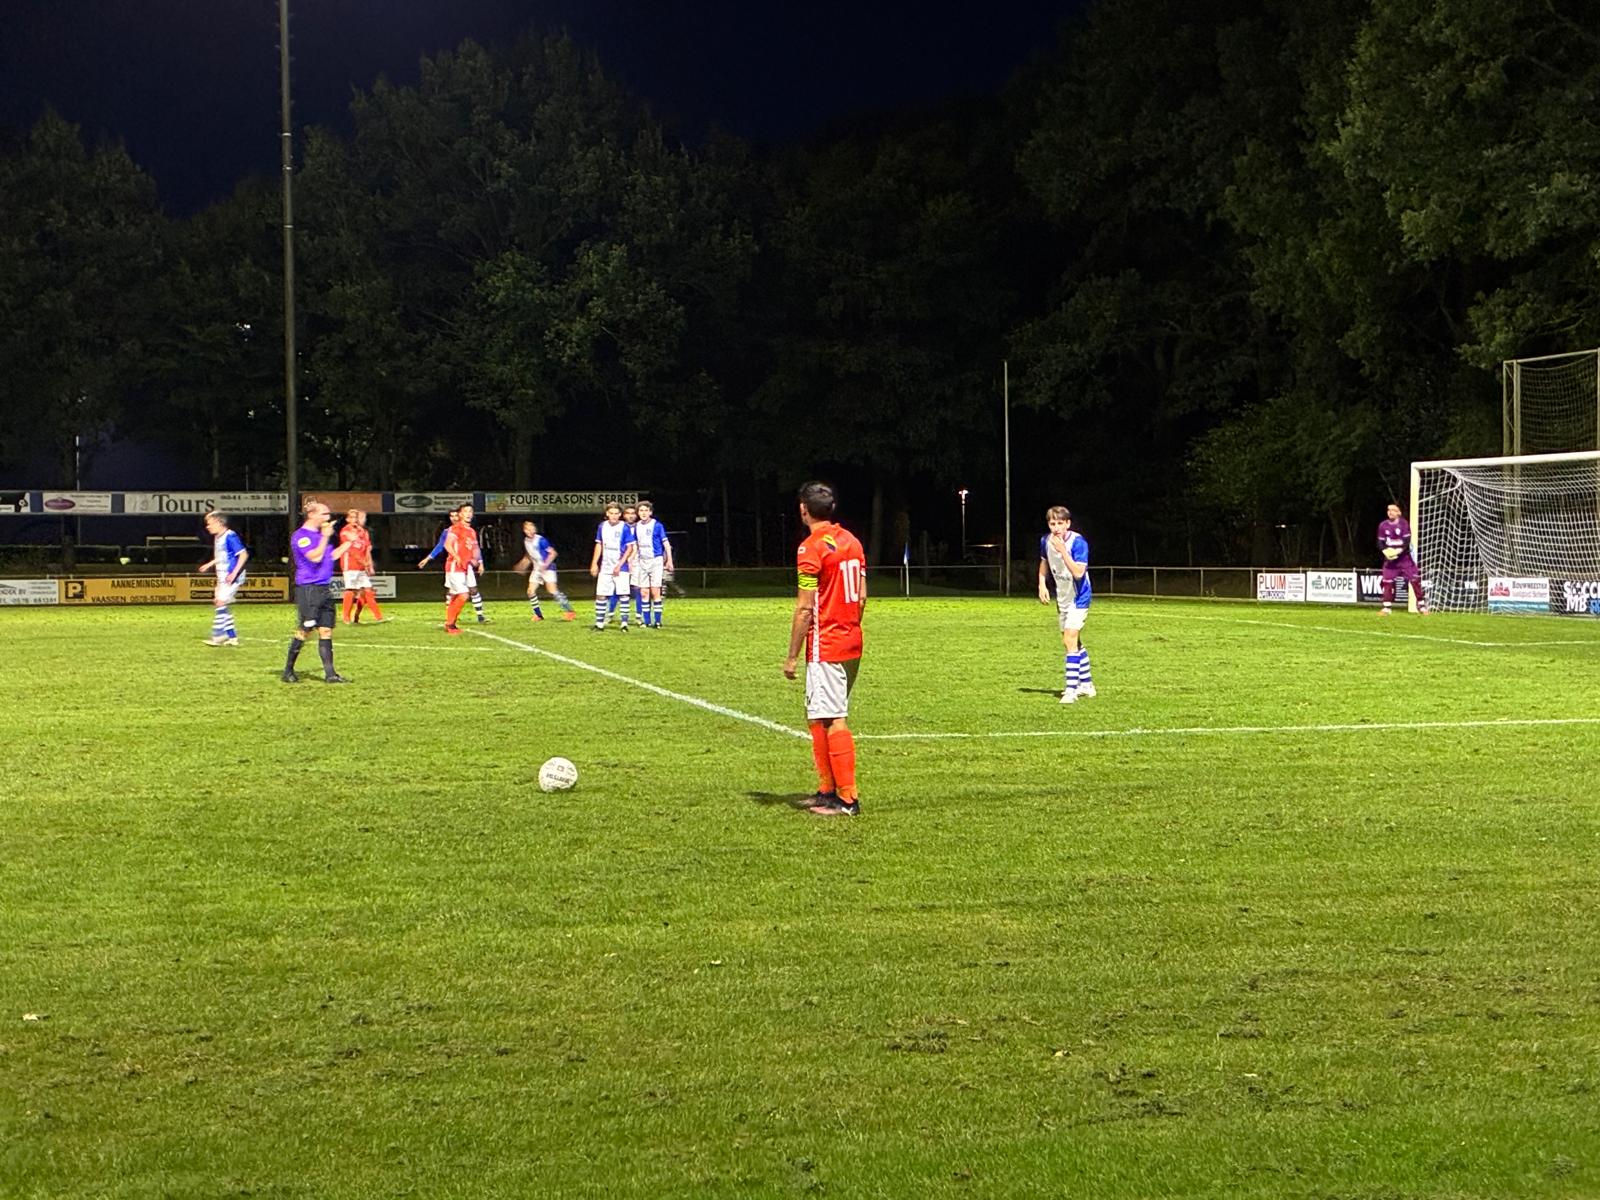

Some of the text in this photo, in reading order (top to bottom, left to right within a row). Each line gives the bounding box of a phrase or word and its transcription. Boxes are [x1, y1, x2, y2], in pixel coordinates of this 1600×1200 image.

[152, 494, 215, 513] Tours
[509, 494, 539, 504] FOUR
[598, 494, 636, 504] SERRES
[839, 558, 861, 604] 10
[1259, 575, 1287, 590] PLUIM
[1325, 576, 1353, 591] KOPPE
[1566, 595, 1587, 612] MB
